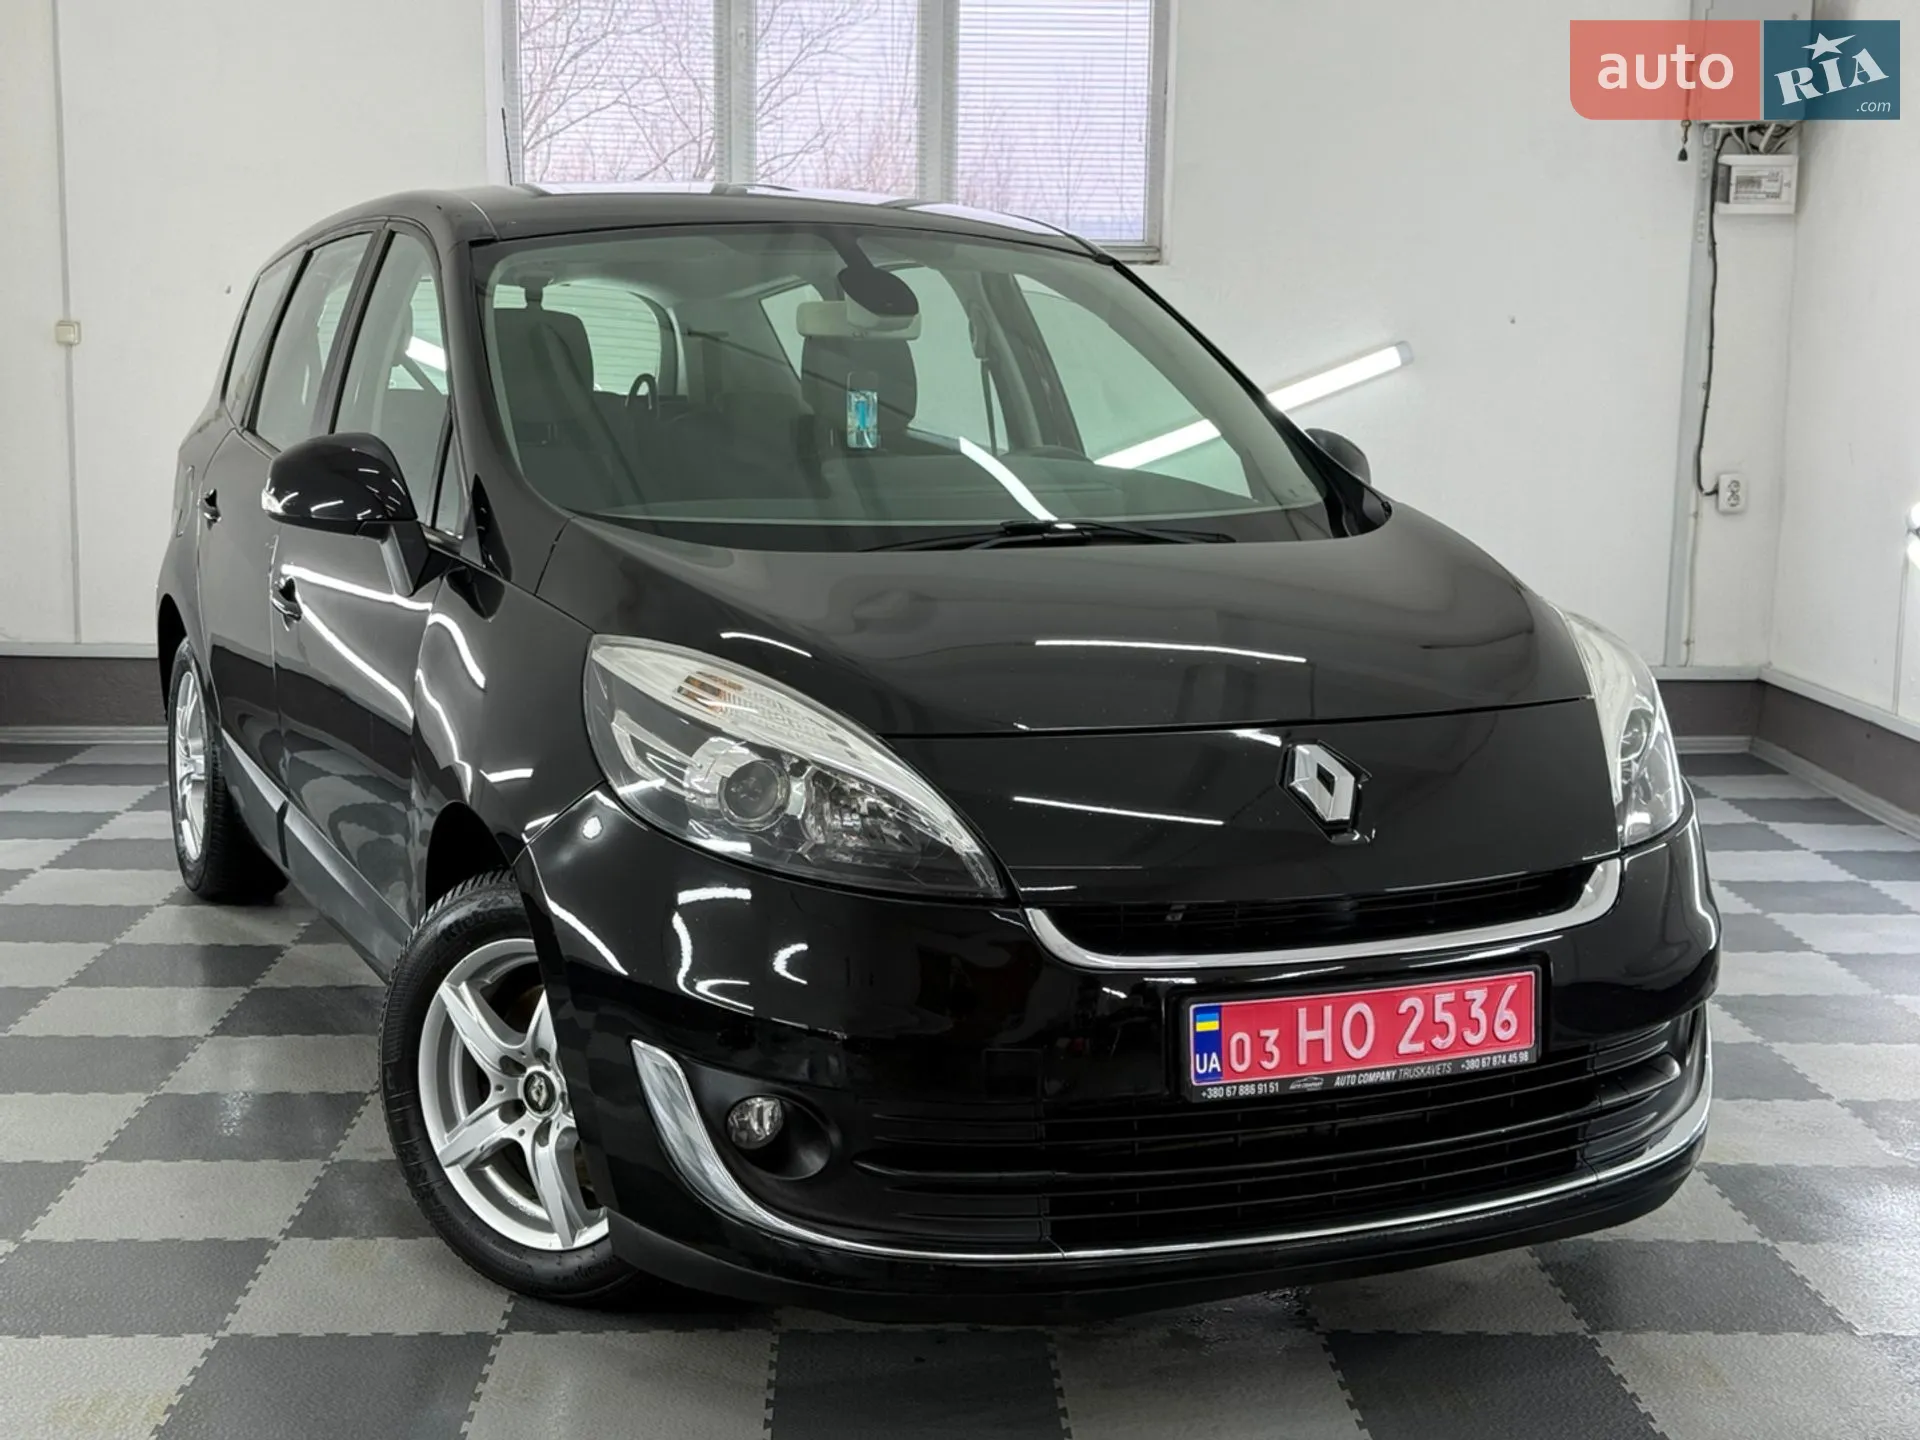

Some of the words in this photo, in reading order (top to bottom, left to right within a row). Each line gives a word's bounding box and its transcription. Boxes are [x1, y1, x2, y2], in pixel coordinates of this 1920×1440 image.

[1229, 1028, 1280, 1073] 03
[1297, 1002, 1375, 1066] HO
[1397, 982, 1519, 1055] 2536
[1195, 1052, 1221, 1075] UA
[1334, 1073, 1357, 1087] AUTO
[1357, 1069, 1398, 1085] COMPANY
[1398, 1062, 1452, 1079] TRUSKAVETS
[1201, 1086, 1224, 1099] +380
[1226, 1085, 1237, 1097] 67
[1269, 1081, 1279, 1093] 51
